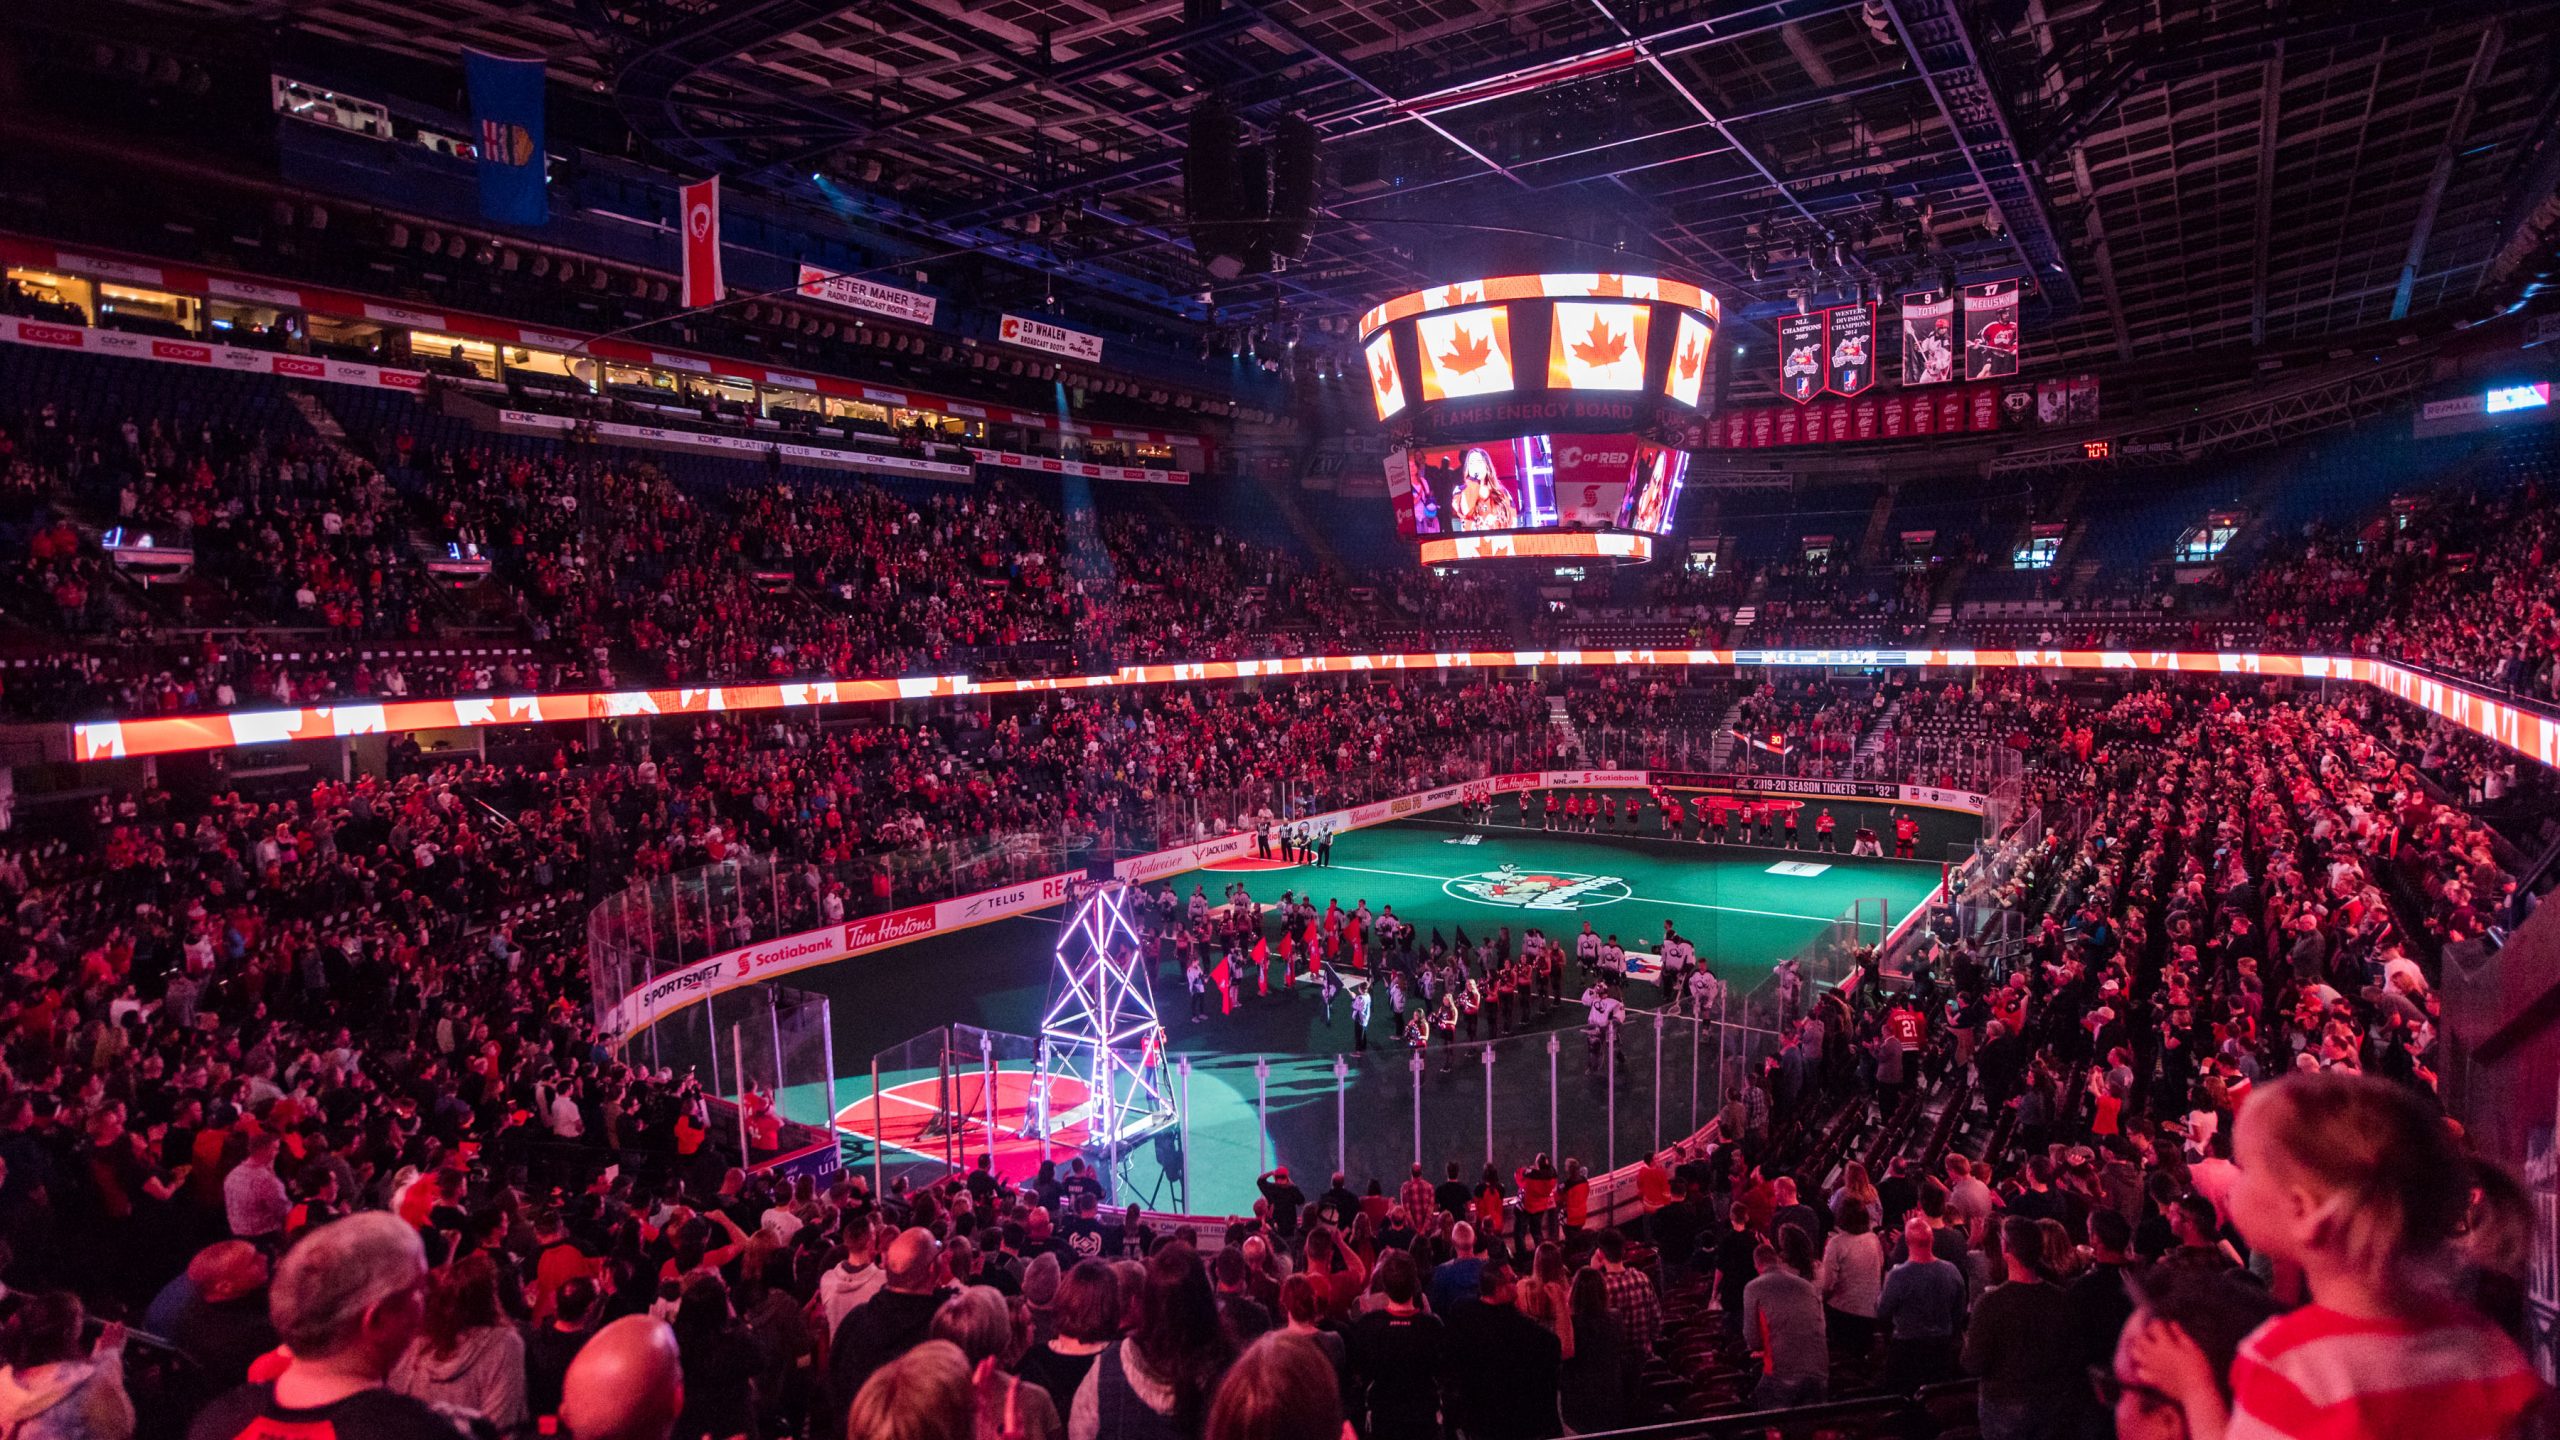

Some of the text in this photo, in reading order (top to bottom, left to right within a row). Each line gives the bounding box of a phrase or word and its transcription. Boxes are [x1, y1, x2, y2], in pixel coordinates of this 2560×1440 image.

[829, 278, 908, 305] PETER MAHER
[1984, 284, 1998, 296] 17
[827, 290, 907, 315] RADIO BROADCAST BOOTH
[1924, 294, 1931, 304] 9
[1835, 308, 1867, 317] WESTERN
[1836, 315, 1866, 324] DIVISION
[1795, 318, 1809, 326] NLL
[1831, 321, 1871, 331] CHAMPIONS
[1023, 321, 1066, 341] ED WHALEN
[1782, 324, 1822, 335] CHAMPIONS
[1021, 335, 1065, 352] BROADCAST BOOTH
[279, 361, 319, 372] CO-OP
[385, 374, 421, 386] CO-OP
[506, 412, 536, 422] ICONIC
[1433, 403, 1633, 427] FLAMES ENERGY BOARD
[786, 446, 810, 455] CLUB
[1583, 453, 1598, 462] OF
[1599, 452, 1629, 464] RED
[1427, 789, 1457, 801] SPORTSNET
[1788, 781, 1820, 793] SEASON
[1823, 782, 1856, 795] TICKETS
[1350, 808, 1386, 825] Budweiser
[1206, 844, 1221, 858] JACK
[1127, 856, 1183, 878] Budweiser
[988, 891, 1025, 908] TELUS
[848, 917, 932, 948] Tim Hortons
[756, 938, 833, 967] Scotiabank
[644, 963, 722, 1008] SPORTSNET
[1902, 1020, 1918, 1038] 21
